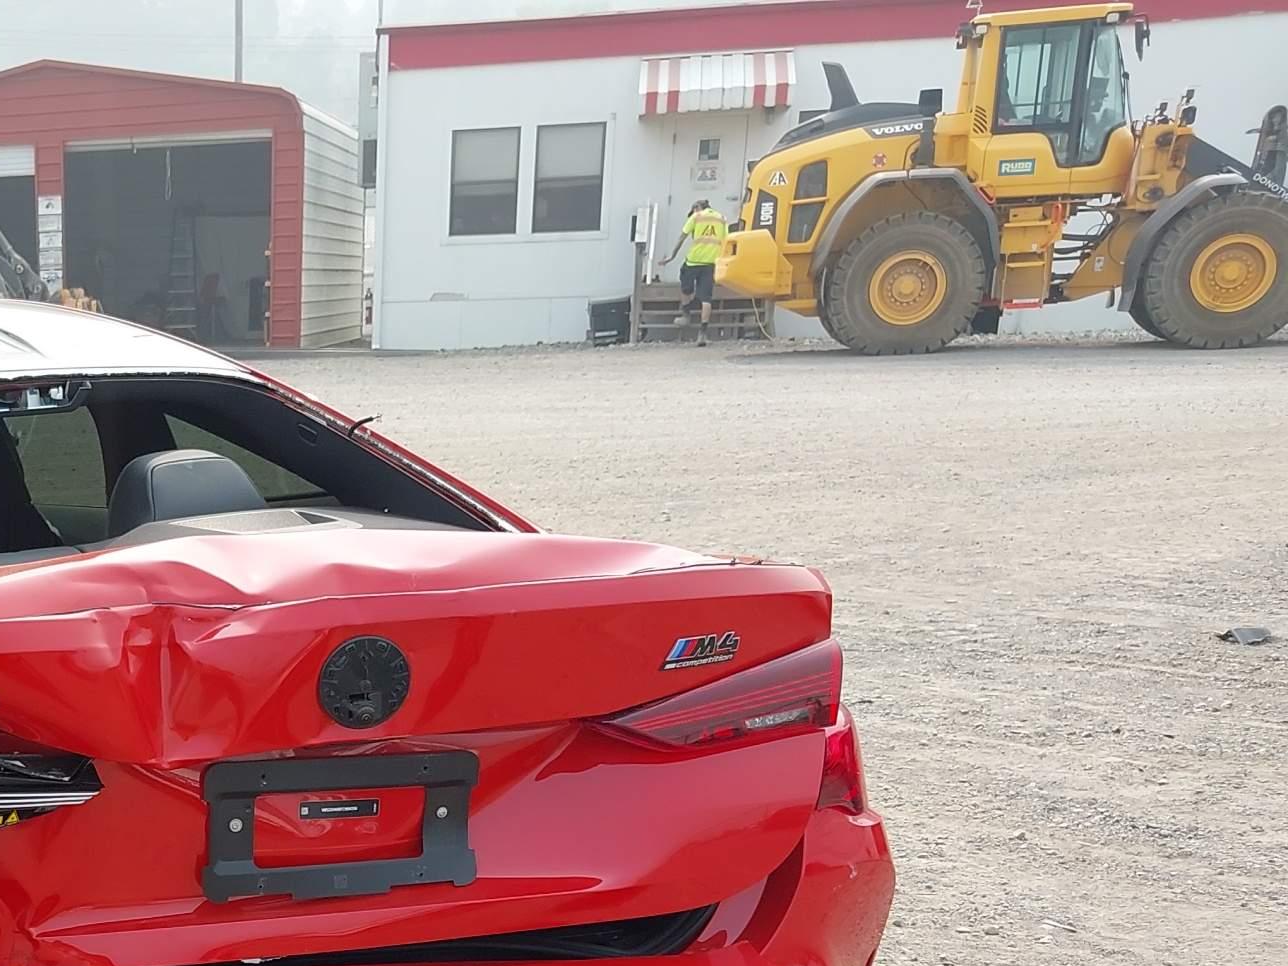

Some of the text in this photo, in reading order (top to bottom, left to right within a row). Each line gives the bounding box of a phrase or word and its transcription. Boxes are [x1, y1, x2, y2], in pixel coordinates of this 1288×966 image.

[872, 123, 923, 136] VOLVO
[686, 631, 741, 658] M4
[675, 654, 734, 668] competition
